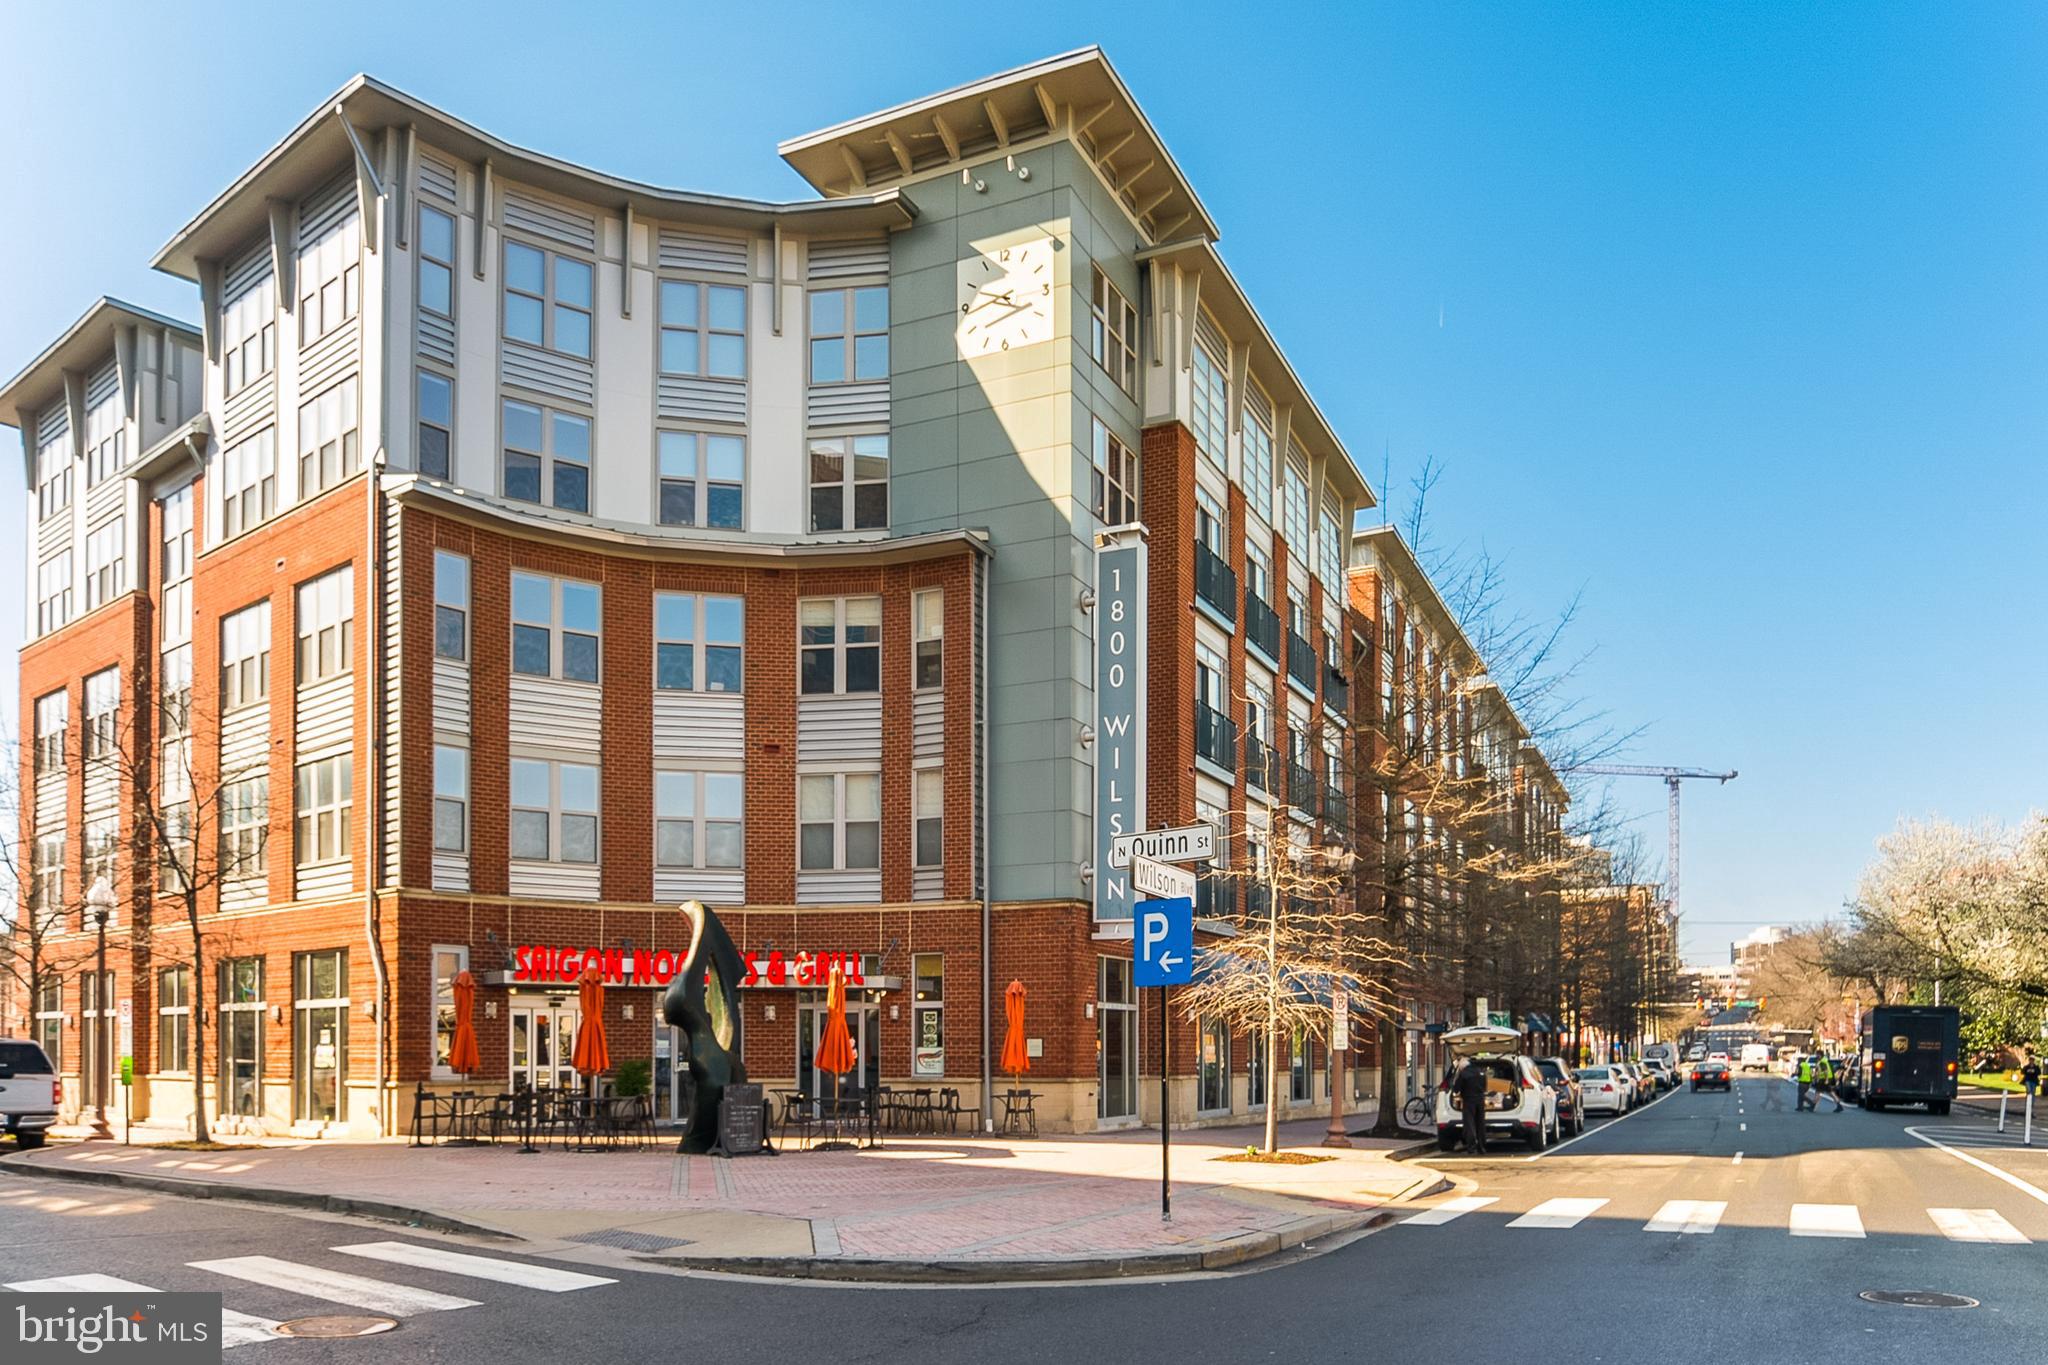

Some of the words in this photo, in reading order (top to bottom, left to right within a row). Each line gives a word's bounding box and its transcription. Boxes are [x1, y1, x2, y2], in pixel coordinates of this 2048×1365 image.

[1000, 249, 1010, 262] 12
[1042, 283, 1050, 296] 3
[961, 303, 970, 316] 9
[1001, 338, 1009, 351] 6
[1110, 568, 1124, 688] 1800
[1118, 847, 1126, 857] N
[1132, 833, 1188, 857] Quinn
[1197, 837, 1209, 849] St
[1138, 862, 1177, 895] Wilson
[1143, 912, 1169, 962] P
[514, 945, 624, 983] SAIGON
[767, 951, 786, 985] &
